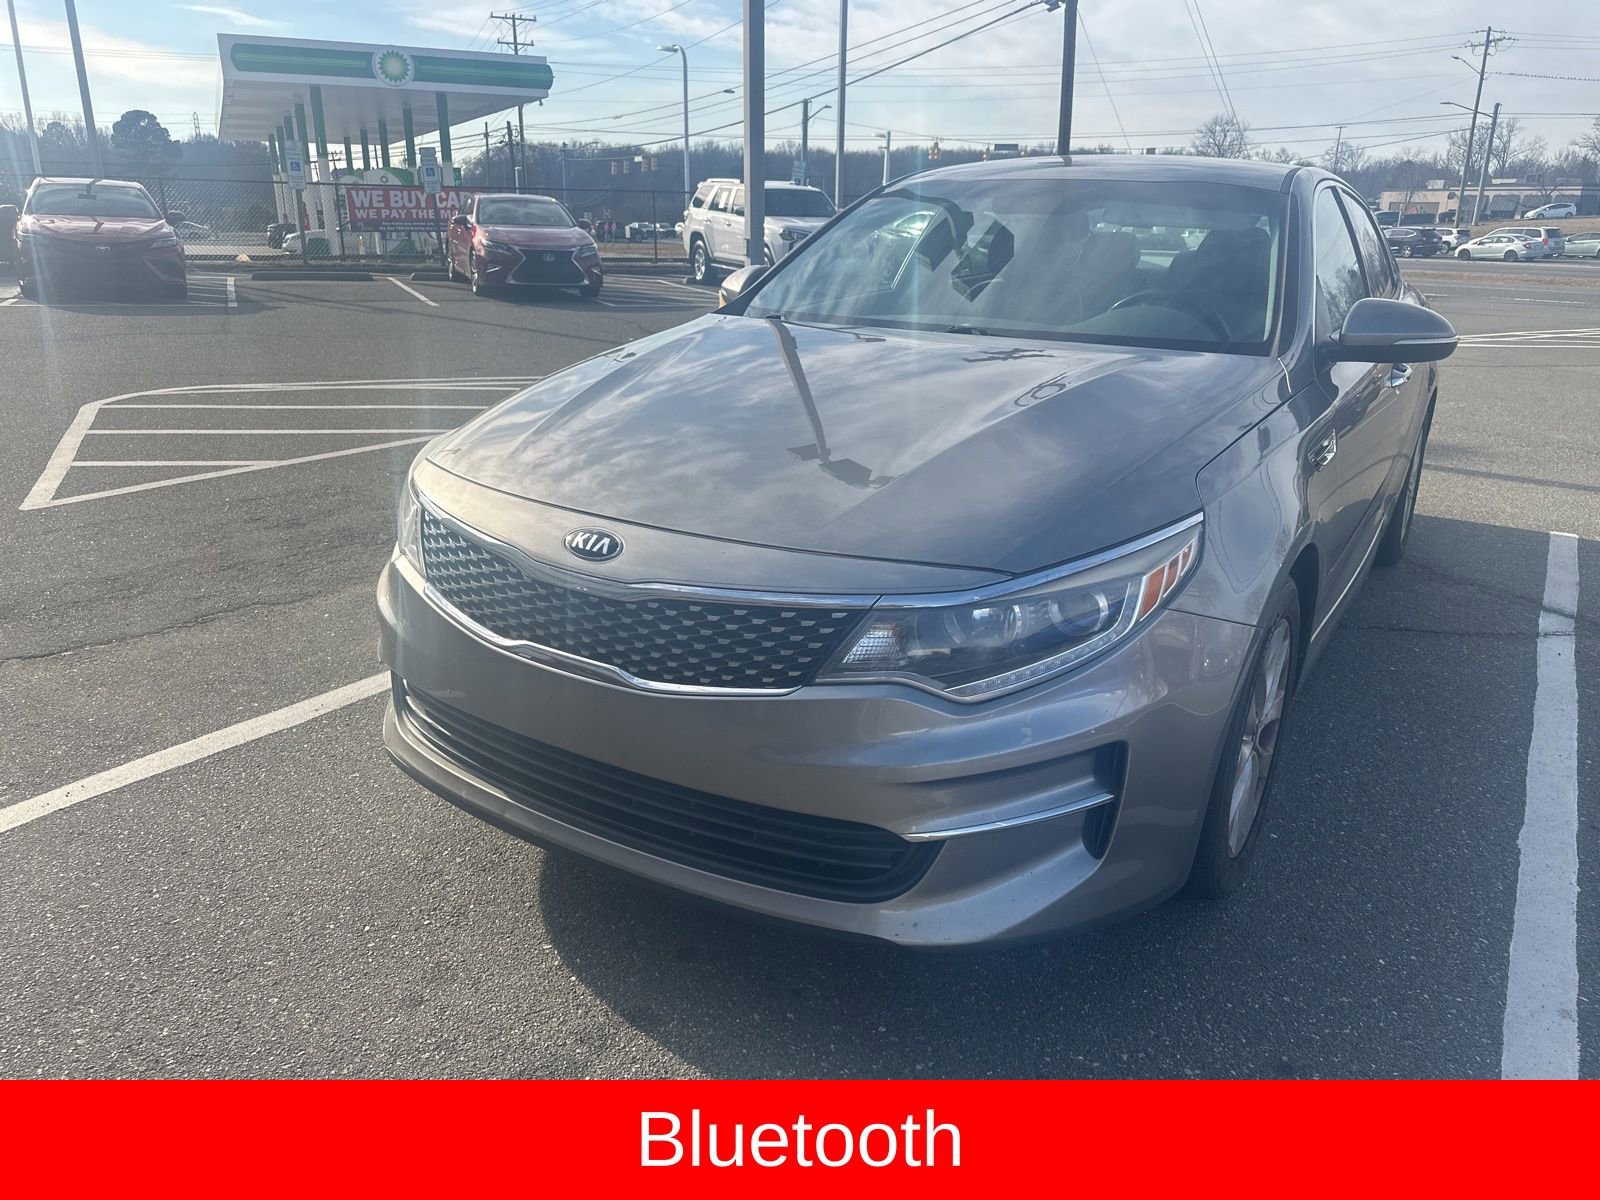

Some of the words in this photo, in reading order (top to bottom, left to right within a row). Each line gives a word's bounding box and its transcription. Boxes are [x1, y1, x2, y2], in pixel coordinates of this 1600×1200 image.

[351, 190, 385, 208] WE
[389, 190, 428, 208] BUY
[354, 209, 377, 219] WE
[382, 209, 407, 219] PAY
[409, 209, 435, 219] THE
[571, 531, 611, 555] KIA
